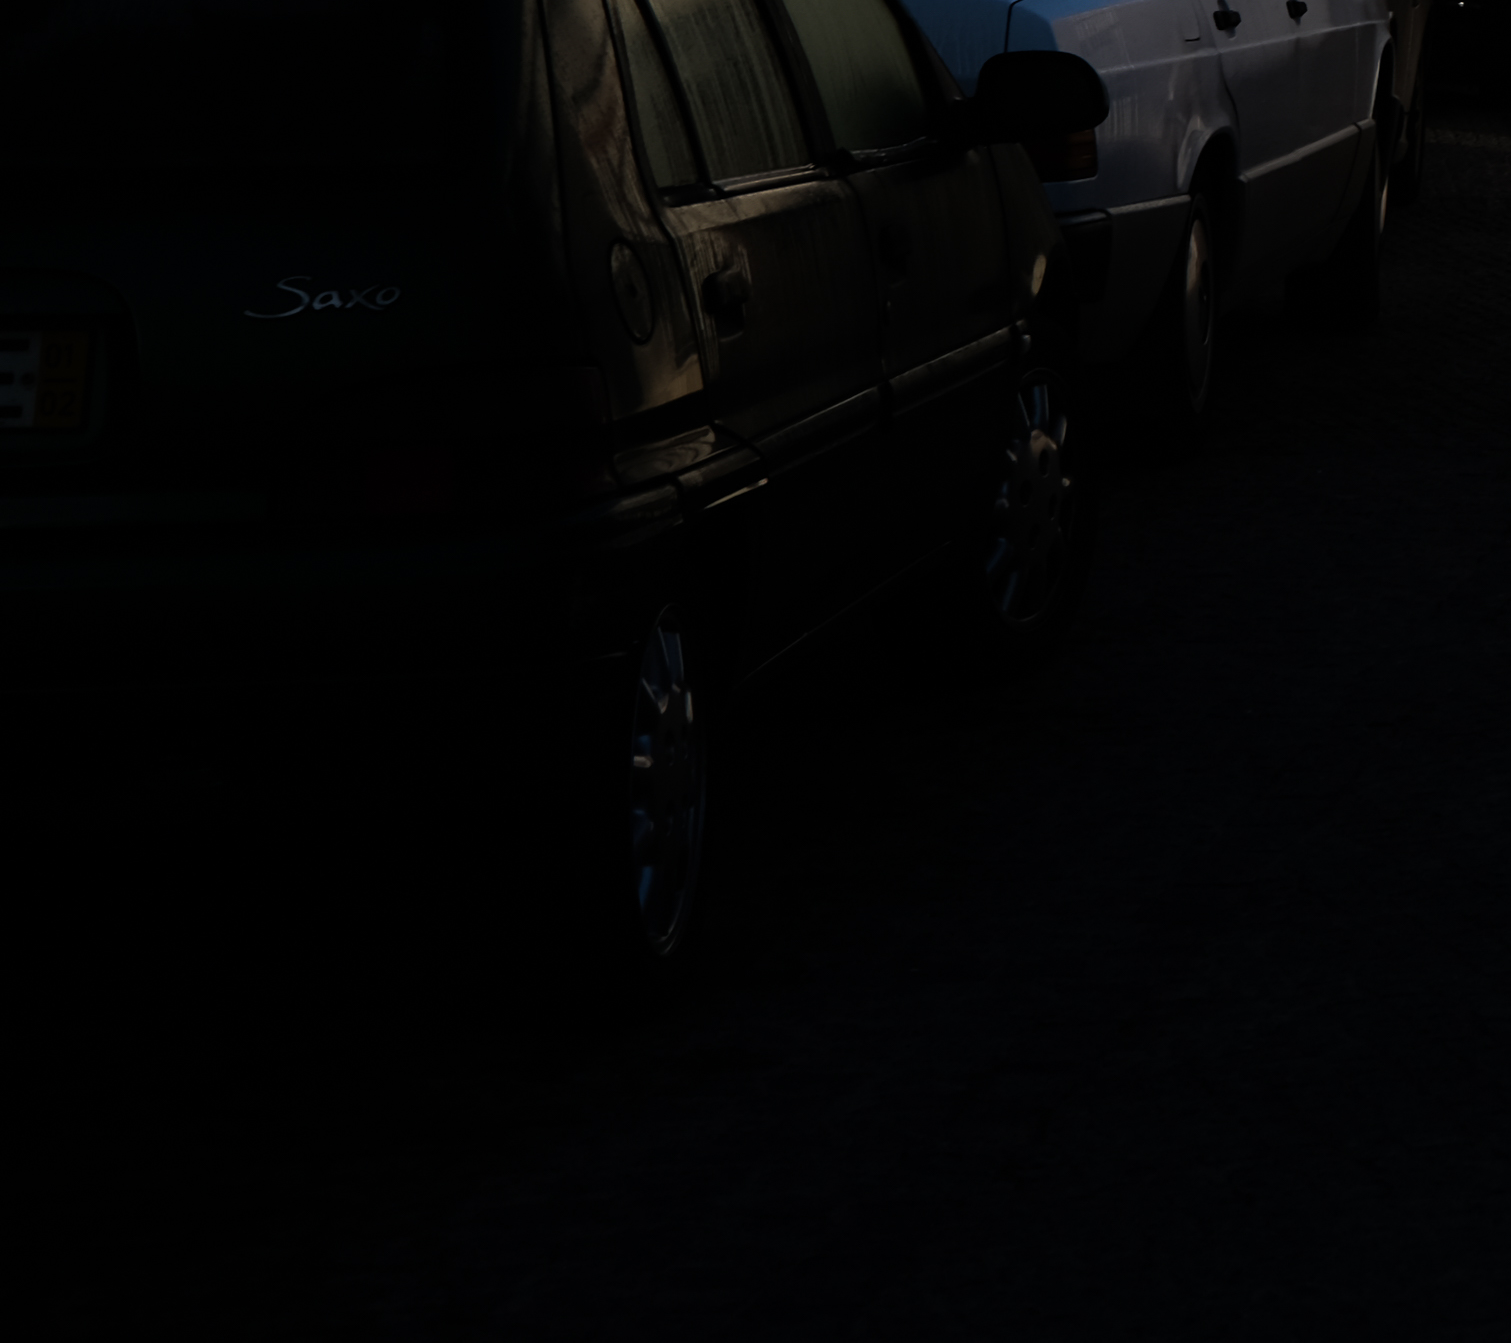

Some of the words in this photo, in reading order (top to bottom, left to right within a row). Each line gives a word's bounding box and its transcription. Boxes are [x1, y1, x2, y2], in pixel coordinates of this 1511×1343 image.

[244, 275, 401, 319] Saxo
[45, 343, 74, 369] 01
[41, 390, 76, 417] 02
